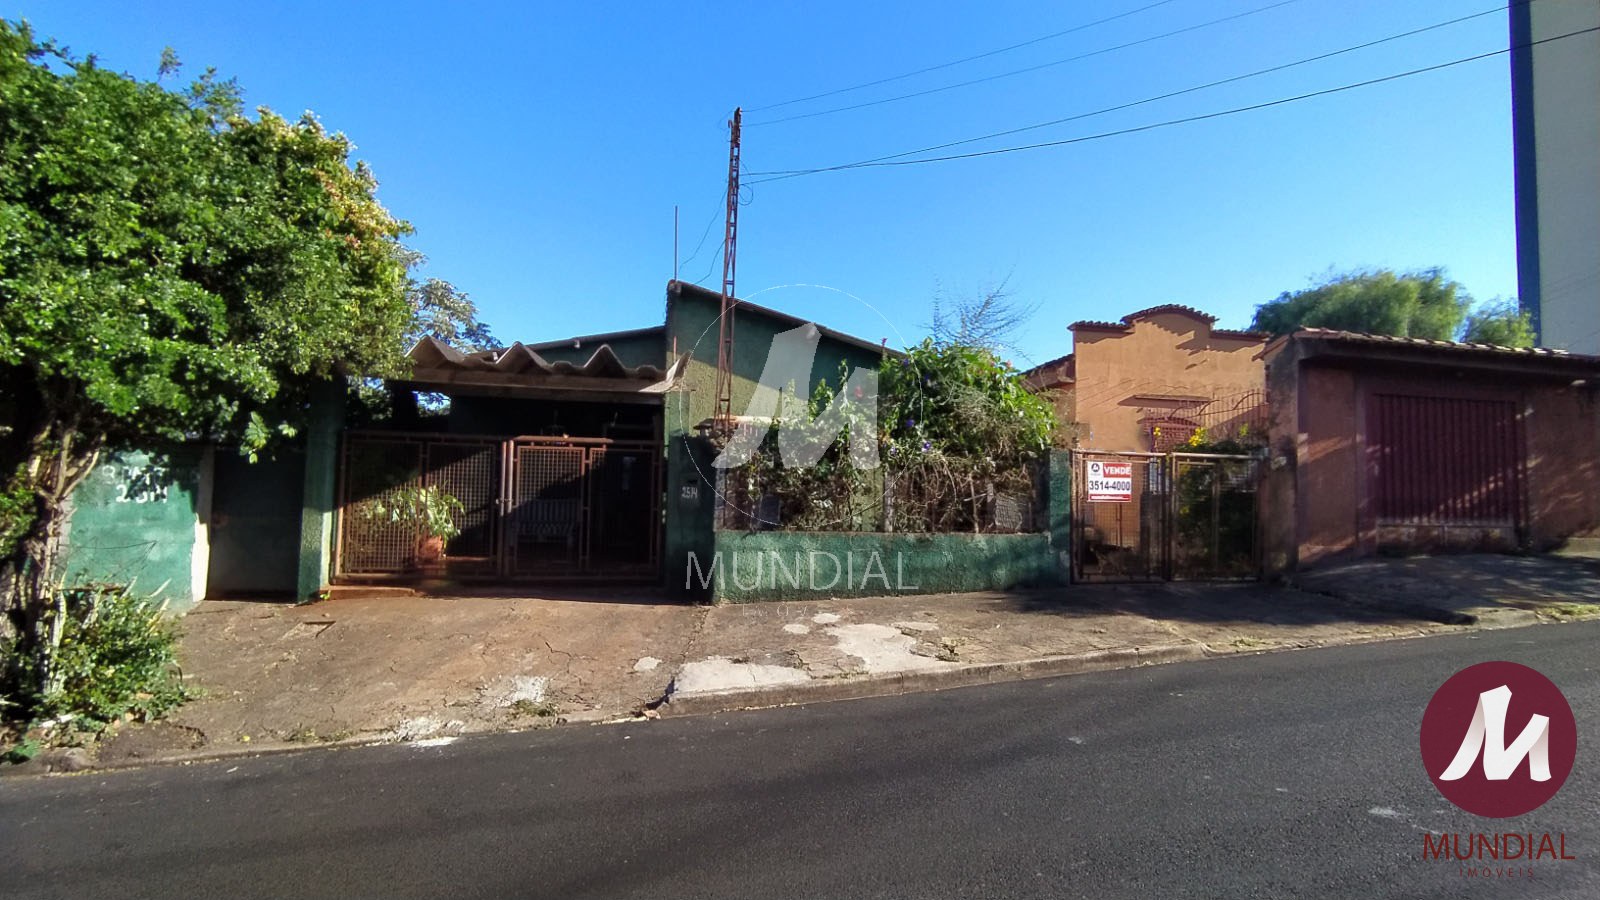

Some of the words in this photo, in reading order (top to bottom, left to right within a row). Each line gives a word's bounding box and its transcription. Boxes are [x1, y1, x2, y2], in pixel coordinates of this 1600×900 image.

[1104, 466, 1132, 475] VENDE
[1089, 480, 1131, 491] 3514-4000
[681, 486, 698, 499] 2514
